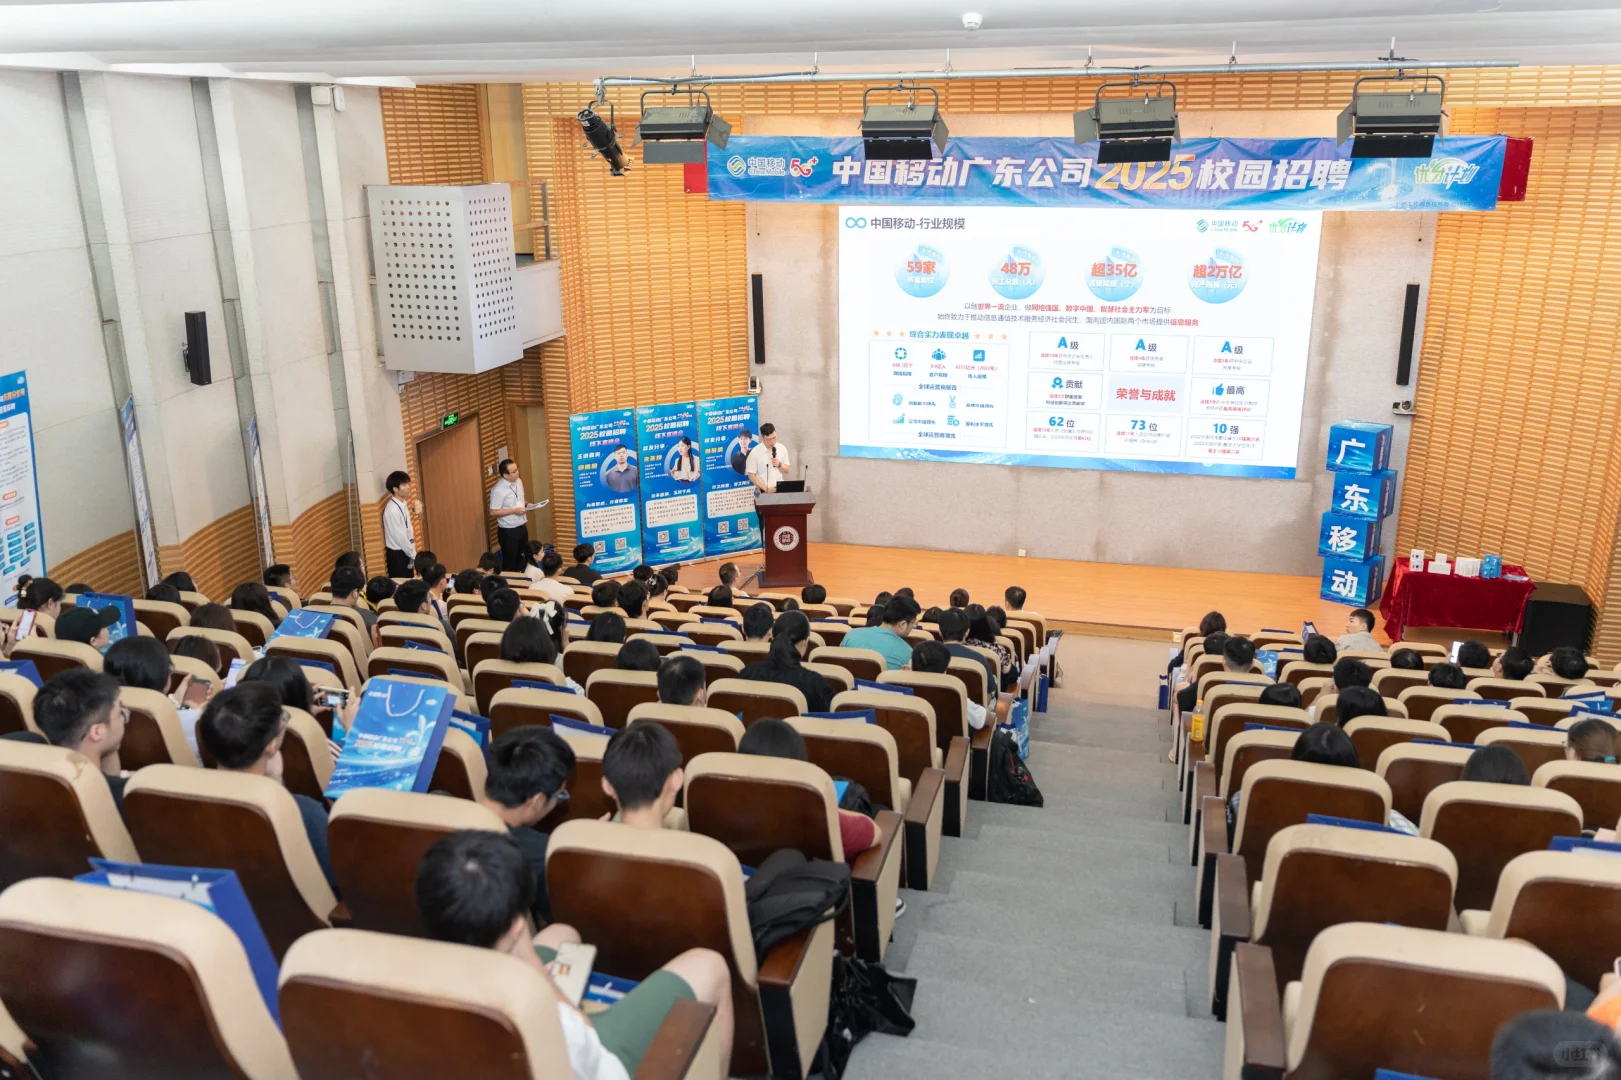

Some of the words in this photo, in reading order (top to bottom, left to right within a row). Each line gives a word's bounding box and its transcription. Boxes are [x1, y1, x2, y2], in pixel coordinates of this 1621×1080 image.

[747, 157, 785, 169] 中国移动
[748, 168, 765, 176] China
[766, 168, 785, 176] Mobile
[870, 217, 965, 230] 中国移动-行业规模
[907, 261, 936, 274] 59家
[1001, 262, 1032, 276] 48万
[1091, 263, 1138, 278] 超35亿
[1193, 265, 1242, 279] 超2万亿
[909, 330, 970, 340] 综合实力表现卓越
[1057, 336, 1068, 348] A
[1070, 341, 1079, 350] 级
[1135, 338, 1146, 351] A
[1148, 343, 1157, 352] 级
[1220, 341, 1232, 353] A
[1234, 345, 1244, 354] 级
[1065, 379, 1083, 389] 贡献
[1226, 385, 1245, 396] 最高
[1116, 387, 1176, 402] 荣誉与成就
[1049, 416, 1064, 427] 62
[1066, 419, 1075, 428] 位
[1130, 419, 1146, 430] 73
[1148, 422, 1158, 431] 位
[1213, 423, 1227, 434] 10
[1229, 425, 1239, 434] 强
